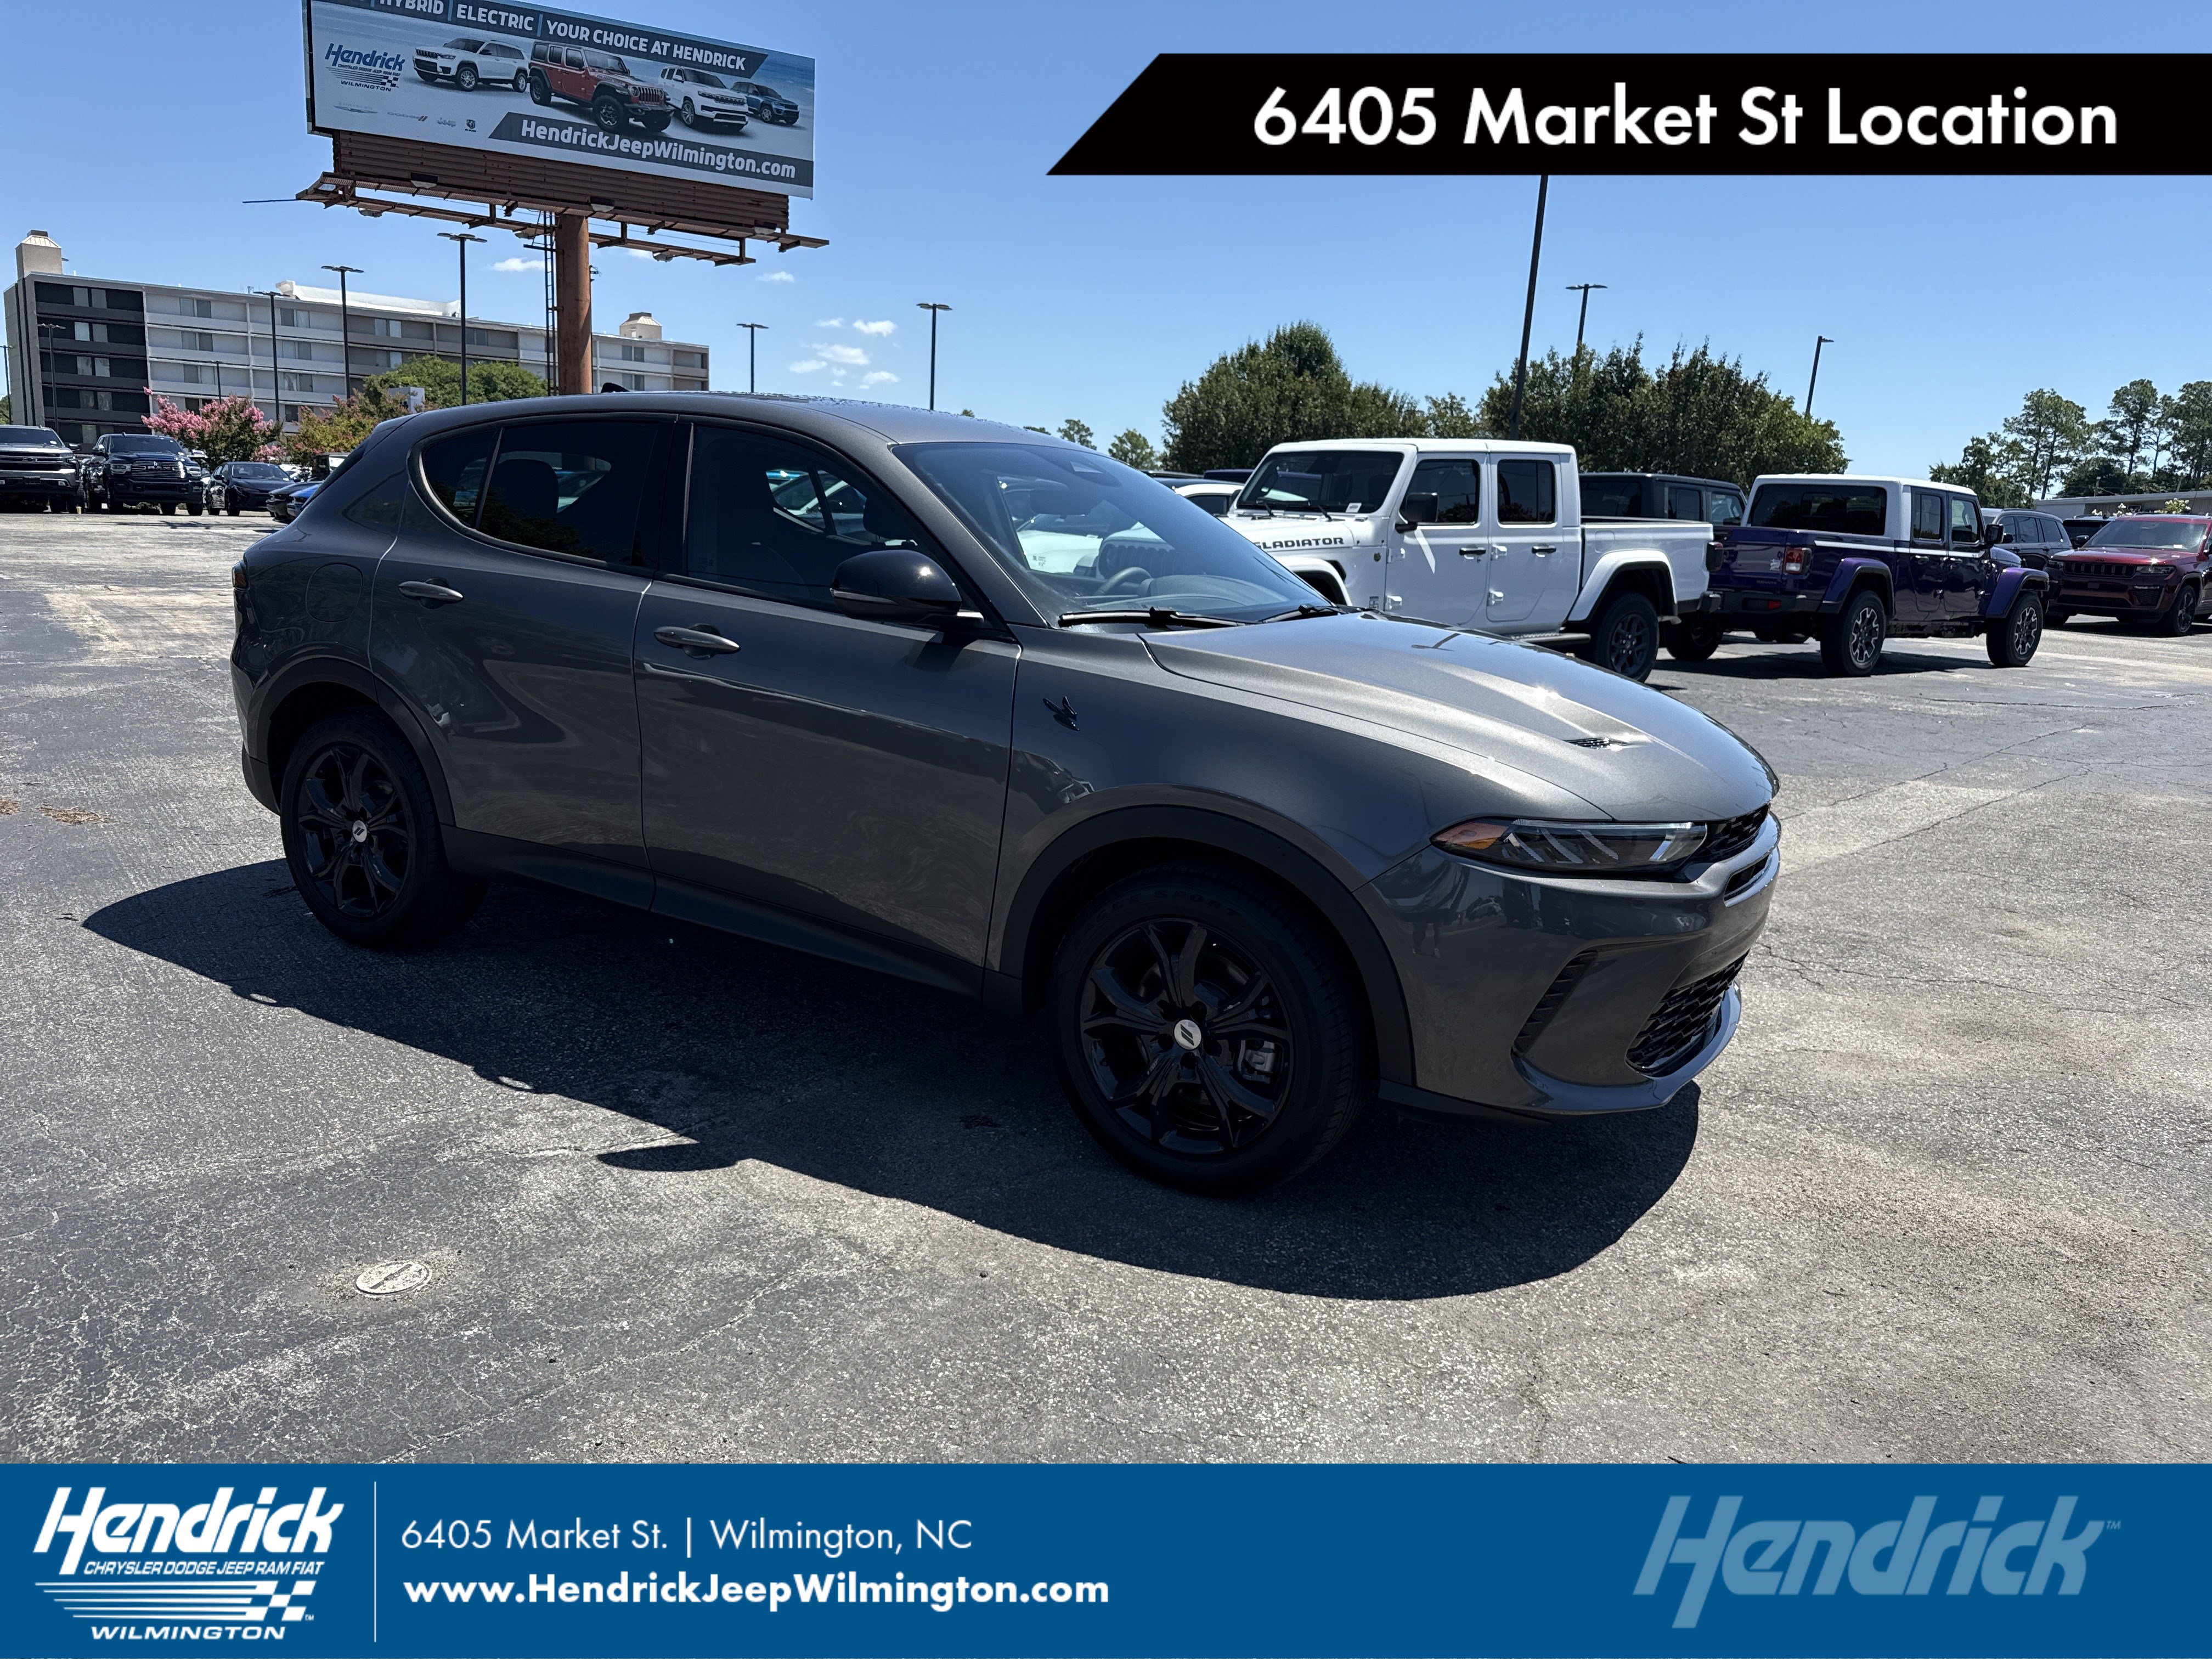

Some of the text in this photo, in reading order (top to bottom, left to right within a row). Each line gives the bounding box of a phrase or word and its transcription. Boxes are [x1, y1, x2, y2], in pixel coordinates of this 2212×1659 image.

[325, 43, 405, 71] Hendrick
[456, 4, 534, 31] ELECTRIC
[546, 20, 590, 41] YOUR
[592, 29, 648, 52] CHOICE
[651, 41, 671, 56] AT
[673, 44, 746, 71] HENDRICK
[341, 80, 392, 92] WILMINGTON
[521, 119, 797, 178] HendrickJeepWilmington.com
